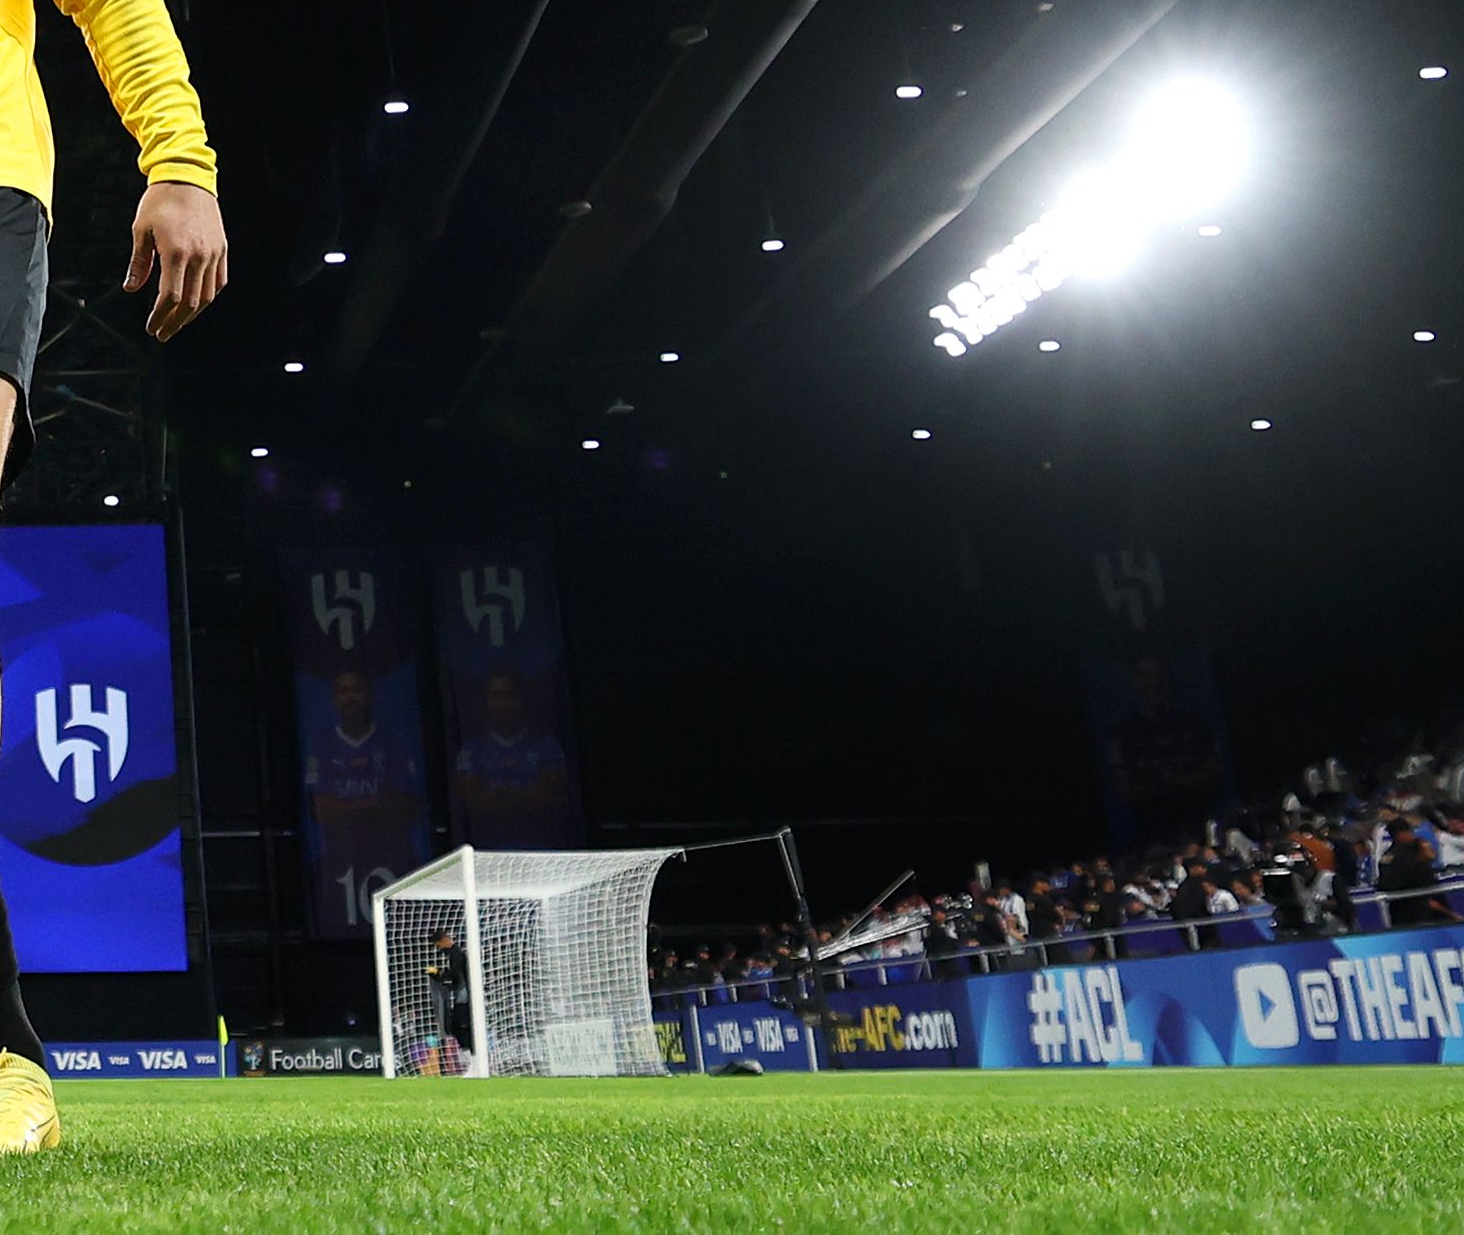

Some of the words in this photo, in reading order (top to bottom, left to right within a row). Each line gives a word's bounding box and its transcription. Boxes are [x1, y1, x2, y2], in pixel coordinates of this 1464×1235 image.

[1297, 948, 1464, 1041] @THEAF
[1030, 967, 1143, 1063] #ACL
[753, 1017, 785, 1053] VISA
[54, 1051, 102, 1071] VISA
[107, 1055, 130, 1066] VISA
[137, 1051, 188, 1071] VISA
[193, 1054, 217, 1065] VISA
[271, 1046, 342, 1072] Football
[348, 1047, 403, 1071] Cars
